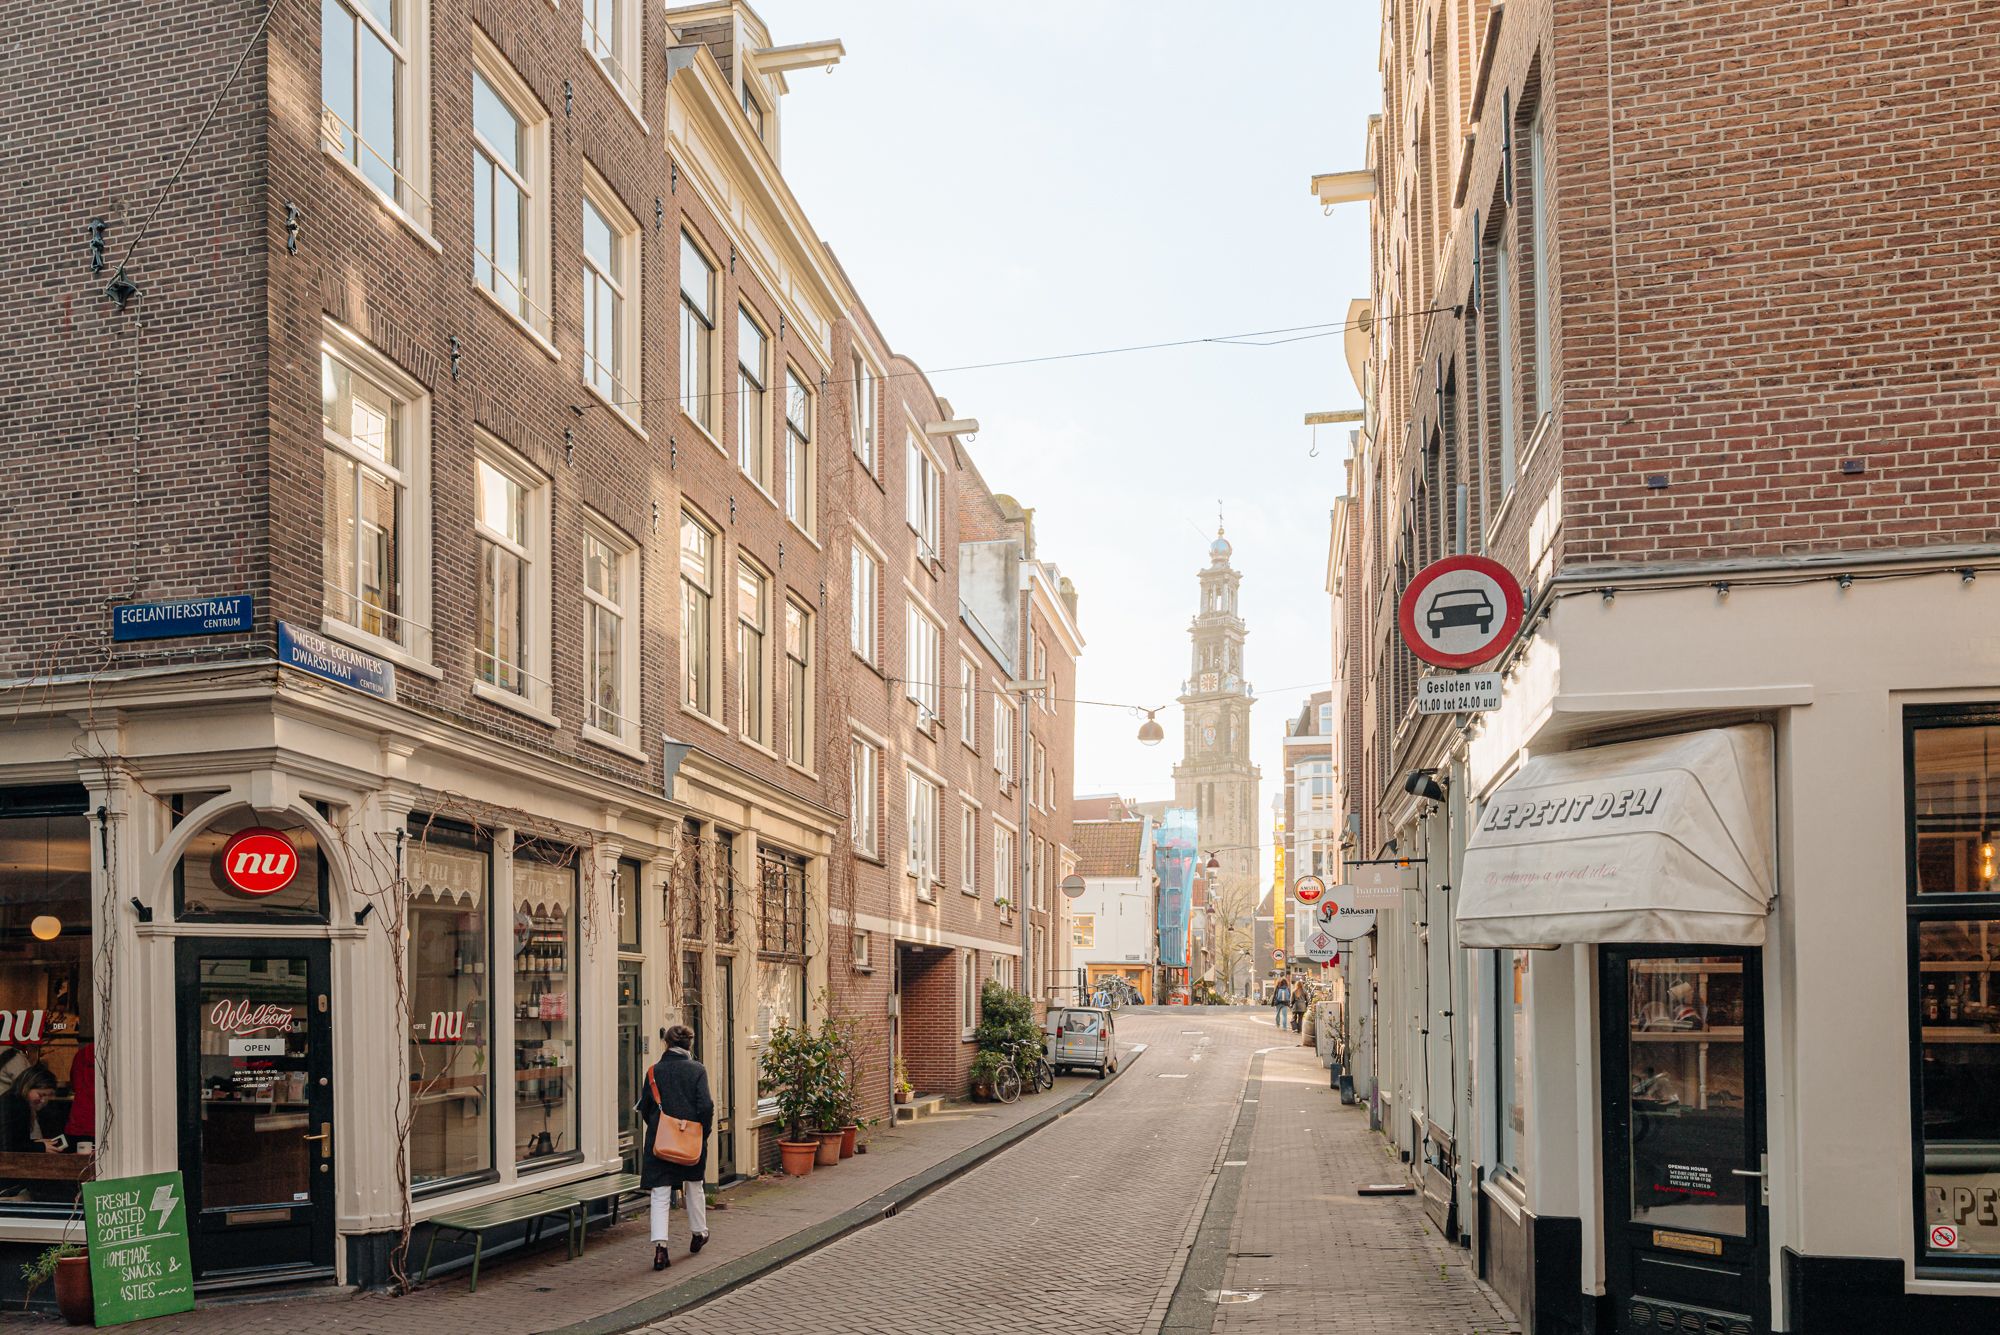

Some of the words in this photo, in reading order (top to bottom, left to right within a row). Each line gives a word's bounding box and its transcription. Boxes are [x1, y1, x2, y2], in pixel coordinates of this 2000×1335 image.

[121, 600, 240, 624] EGELANTIERSSTRAAT
[203, 617, 240, 629] CENTRUM
[292, 647, 352, 680] DWARSSTRAAT
[293, 630, 326, 655] TWEEDE
[331, 645, 382, 675] EGELANTIERS
[360, 679, 384, 694] CENTRUM
[1427, 680, 1470, 693] Gesloten
[1475, 680, 1492, 691] van
[1420, 699, 1440, 711] 11.00
[1444, 699, 1455, 710] tot
[1459, 696, 1480, 709] 24.00
[1484, 698, 1497, 707] uur
[1484, 804, 1518, 831] LE
[1514, 795, 1594, 828] PETIT
[1592, 787, 1662, 820] DELI
[233, 852, 290, 874] nu
[211, 999, 293, 1036] Welkom
[429, 1011, 464, 1041] nu
[244, 1044, 271, 1052] OPEN
[95, 1190, 141, 1212] FRESHLY
[97, 1206, 146, 1228] ROASTED
[98, 1223, 145, 1242] COFFEE
[122, 1262, 162, 1282] SNACKS
[169, 1256, 182, 1272] &
